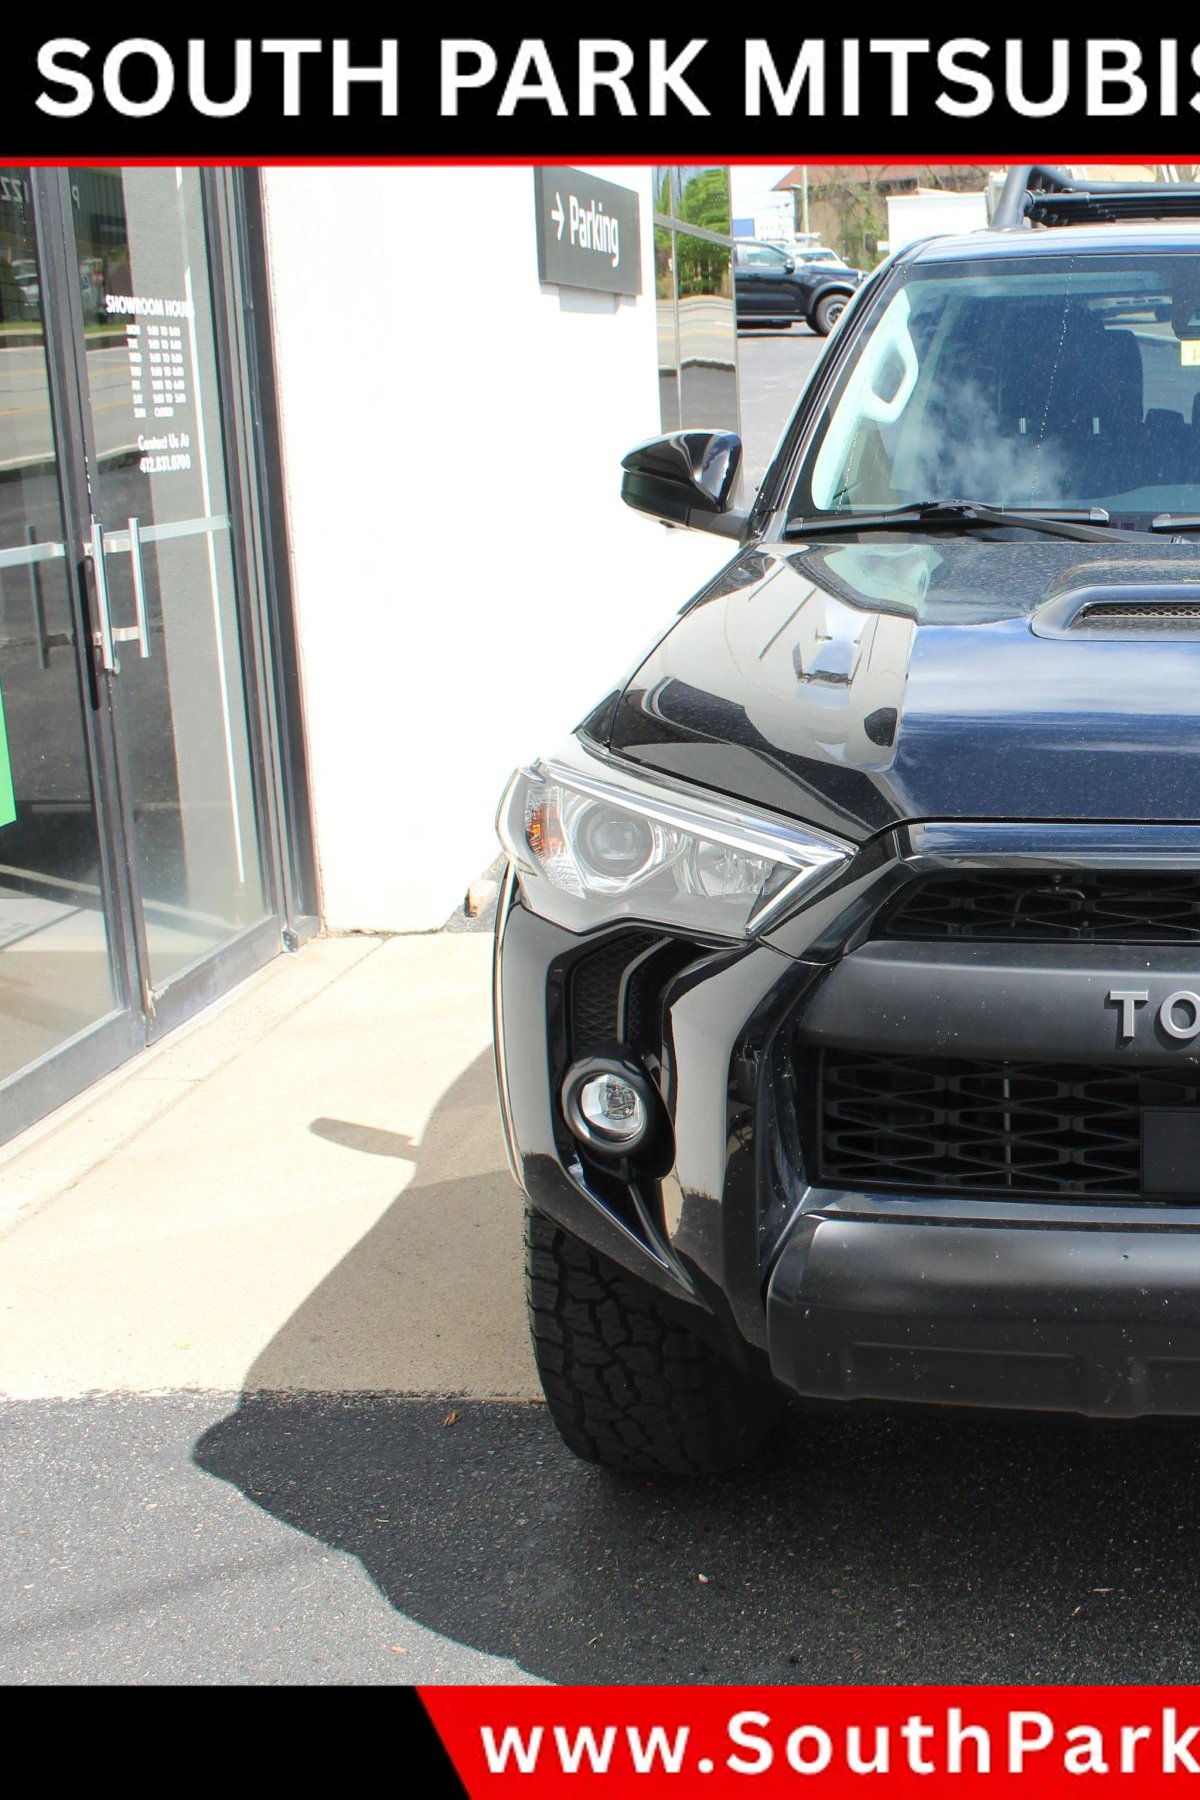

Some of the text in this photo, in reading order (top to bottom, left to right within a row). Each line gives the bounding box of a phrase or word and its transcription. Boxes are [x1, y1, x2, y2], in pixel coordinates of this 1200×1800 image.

[569, 195, 619, 268] Parking
[106, 295, 164, 316] SHOWROOM
[137, 434, 168, 451] Contact
[168, 433, 179, 449] Us
